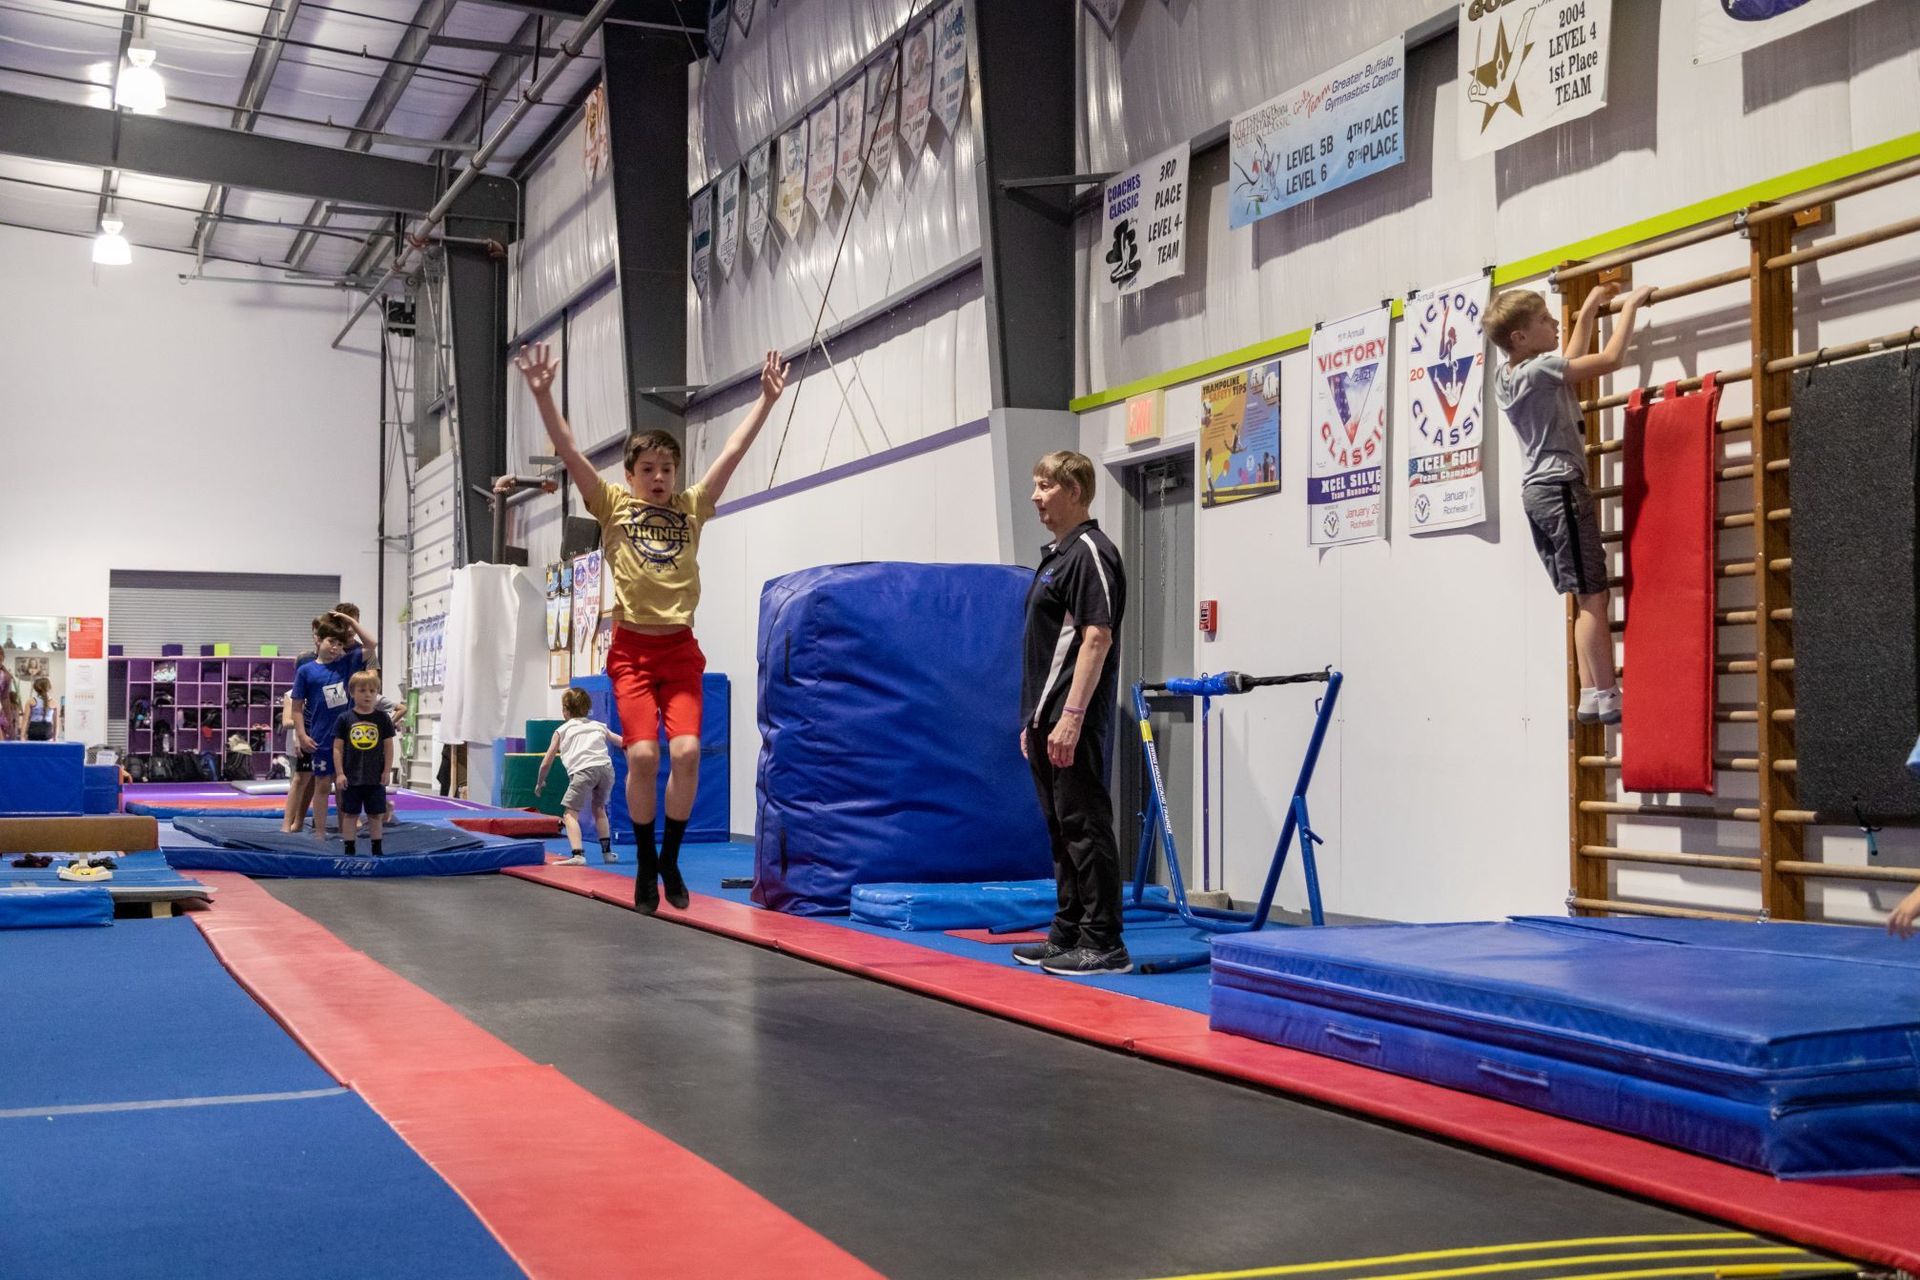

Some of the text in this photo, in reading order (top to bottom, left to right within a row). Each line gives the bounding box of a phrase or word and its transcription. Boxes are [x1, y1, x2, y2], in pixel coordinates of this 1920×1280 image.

[1559, 1, 1586, 28] 2004
[1549, 21, 1597, 59] LEVEL 4
[1332, 56, 1394, 93] Greater Buffalo
[1549, 50, 1598, 84] 1st Place
[1324, 68, 1401, 112] Gymnastics Center
[1555, 74, 1591, 106] TEAM
[1346, 105, 1399, 143] 4TH PLACE
[1286, 135, 1334, 171] LEVEL 5B
[1347, 133, 1399, 169] 8TH PLACE
[1160, 159, 1177, 181] 3RD
[1286, 163, 1327, 196] LEVEL 6
[1107, 174, 1141, 203] COACHES
[1154, 183, 1182, 211] PLACE
[1109, 193, 1139, 220] CLASSIC
[1148, 216, 1172, 242] LEVEL
[1157, 240, 1179, 265] TEAM
[1317, 337, 1386, 373] VICTORY
[1410, 352, 1483, 381] 20 2
[1202, 375, 1240, 396] TRAMPOLINE
[1232, 383, 1247, 396] TIPS
[1354, 371, 1371, 383] 2021
[1417, 455, 1445, 473] XCEL
[1321, 469, 1381, 494] XCEL SILVE
[1331, 491, 1345, 500] Team
[1443, 490, 1468, 503] January
[1345, 507, 1370, 519] January
[622, 524, 690, 543] VIKINGS
